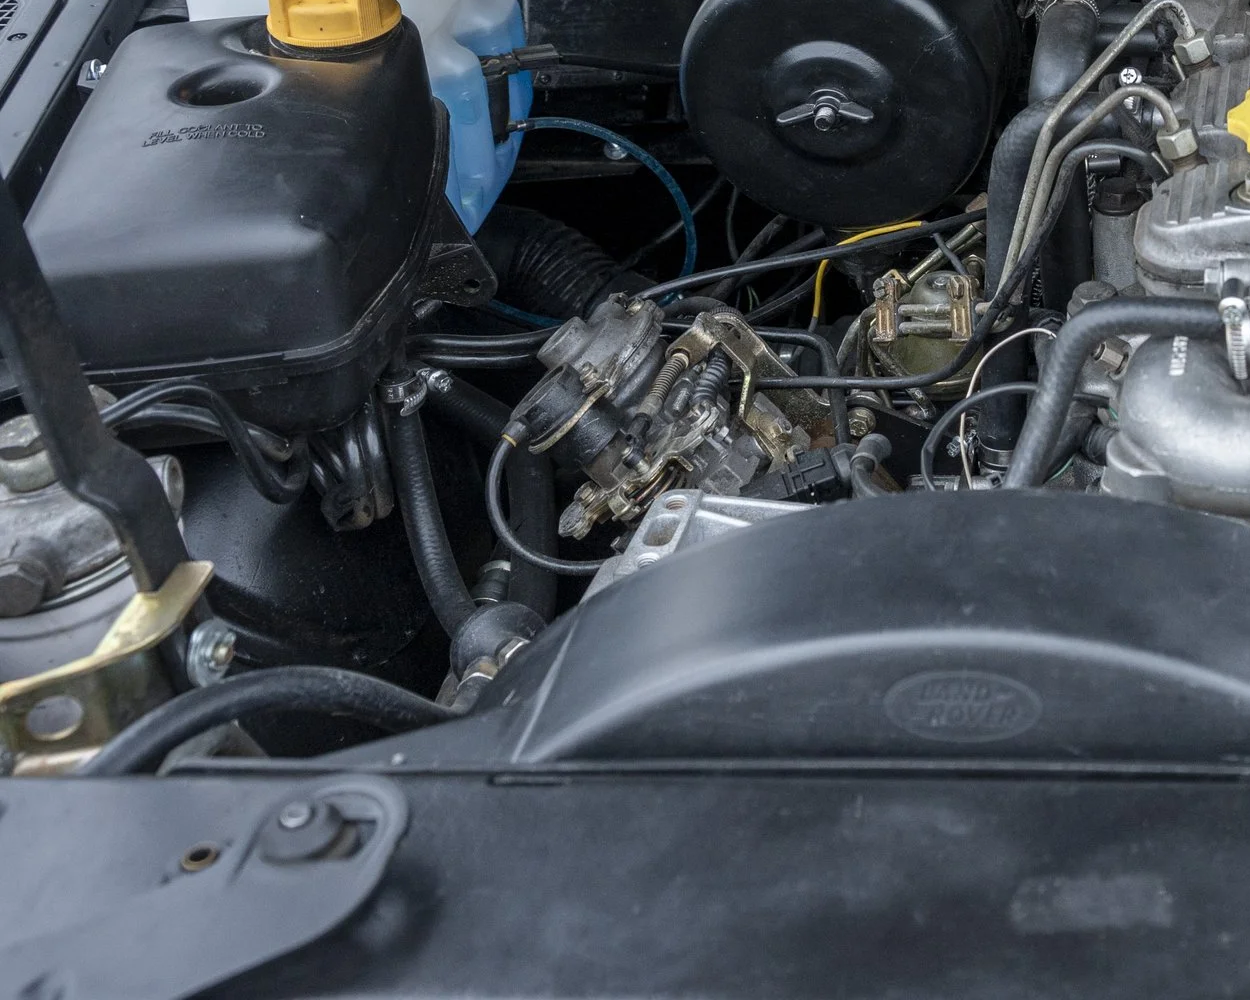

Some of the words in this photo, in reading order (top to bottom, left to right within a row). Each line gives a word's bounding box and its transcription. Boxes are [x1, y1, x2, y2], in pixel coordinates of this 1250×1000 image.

[245, 123, 263, 131] TO
[141, 134, 183, 148] LEVEL
[227, 129, 266, 139] COLD
[927, 702, 1019, 727] ROVER
